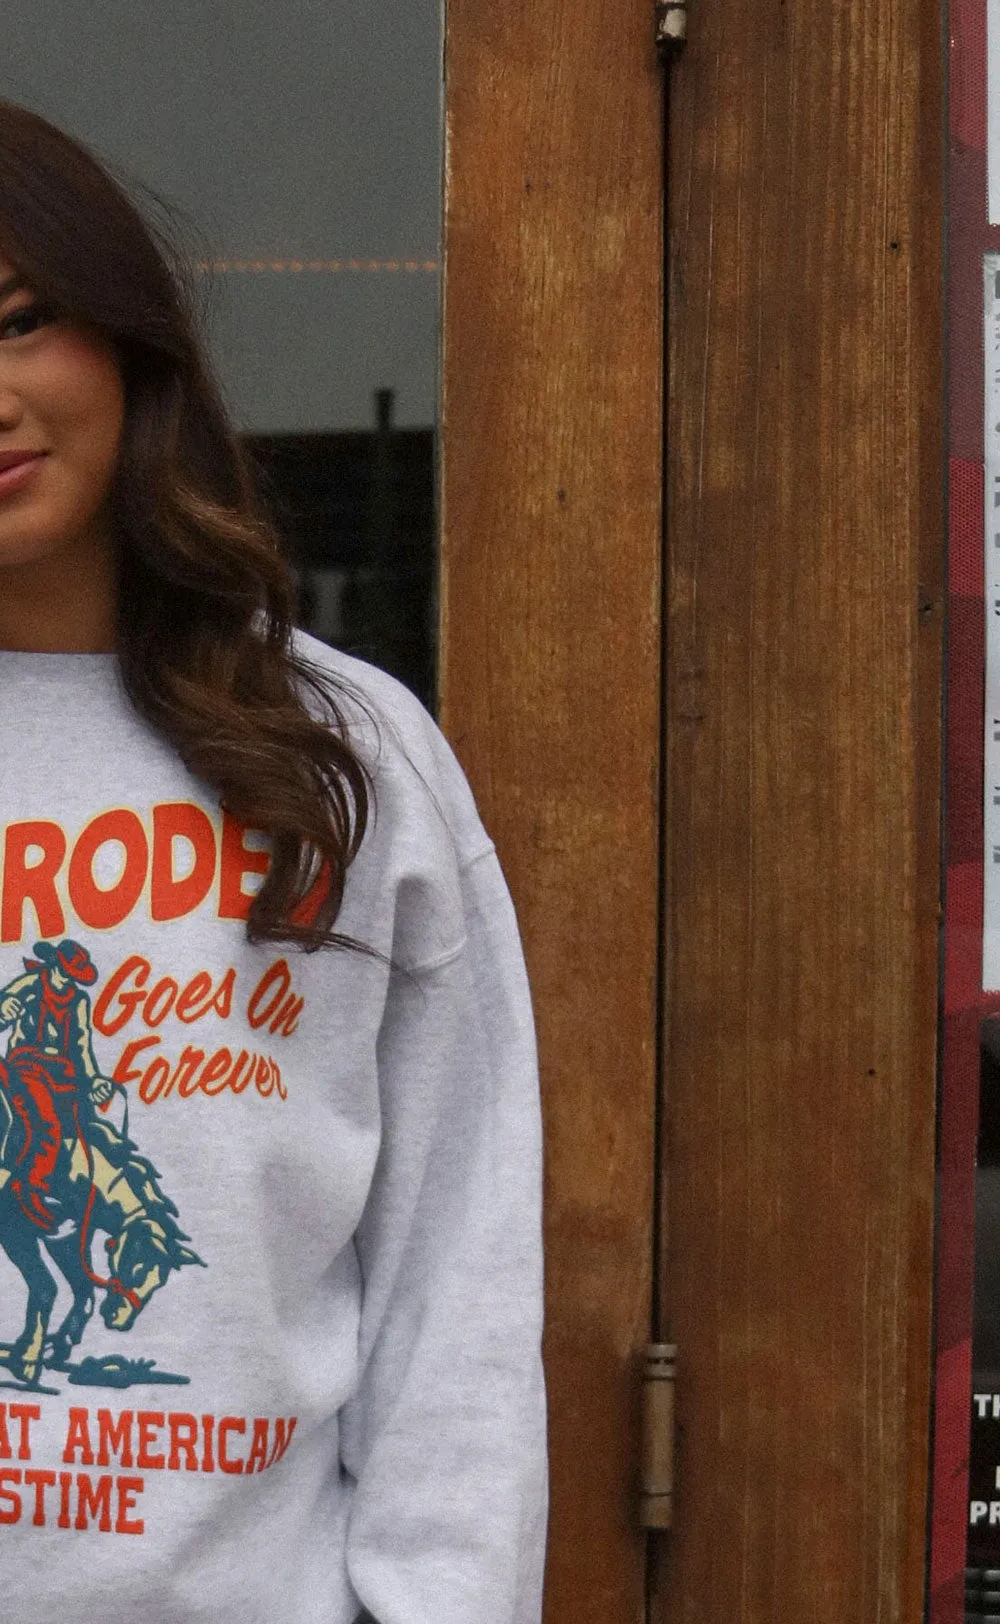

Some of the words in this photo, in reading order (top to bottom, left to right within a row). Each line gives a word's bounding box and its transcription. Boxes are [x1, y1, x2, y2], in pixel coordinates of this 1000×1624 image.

[0, 802, 333, 944] RODE
[92, 955, 237, 1037] Goes
[247, 958, 304, 1037] On
[98, 1035, 288, 1113] Forever
[63, 1406, 298, 1474] AMERICAN
